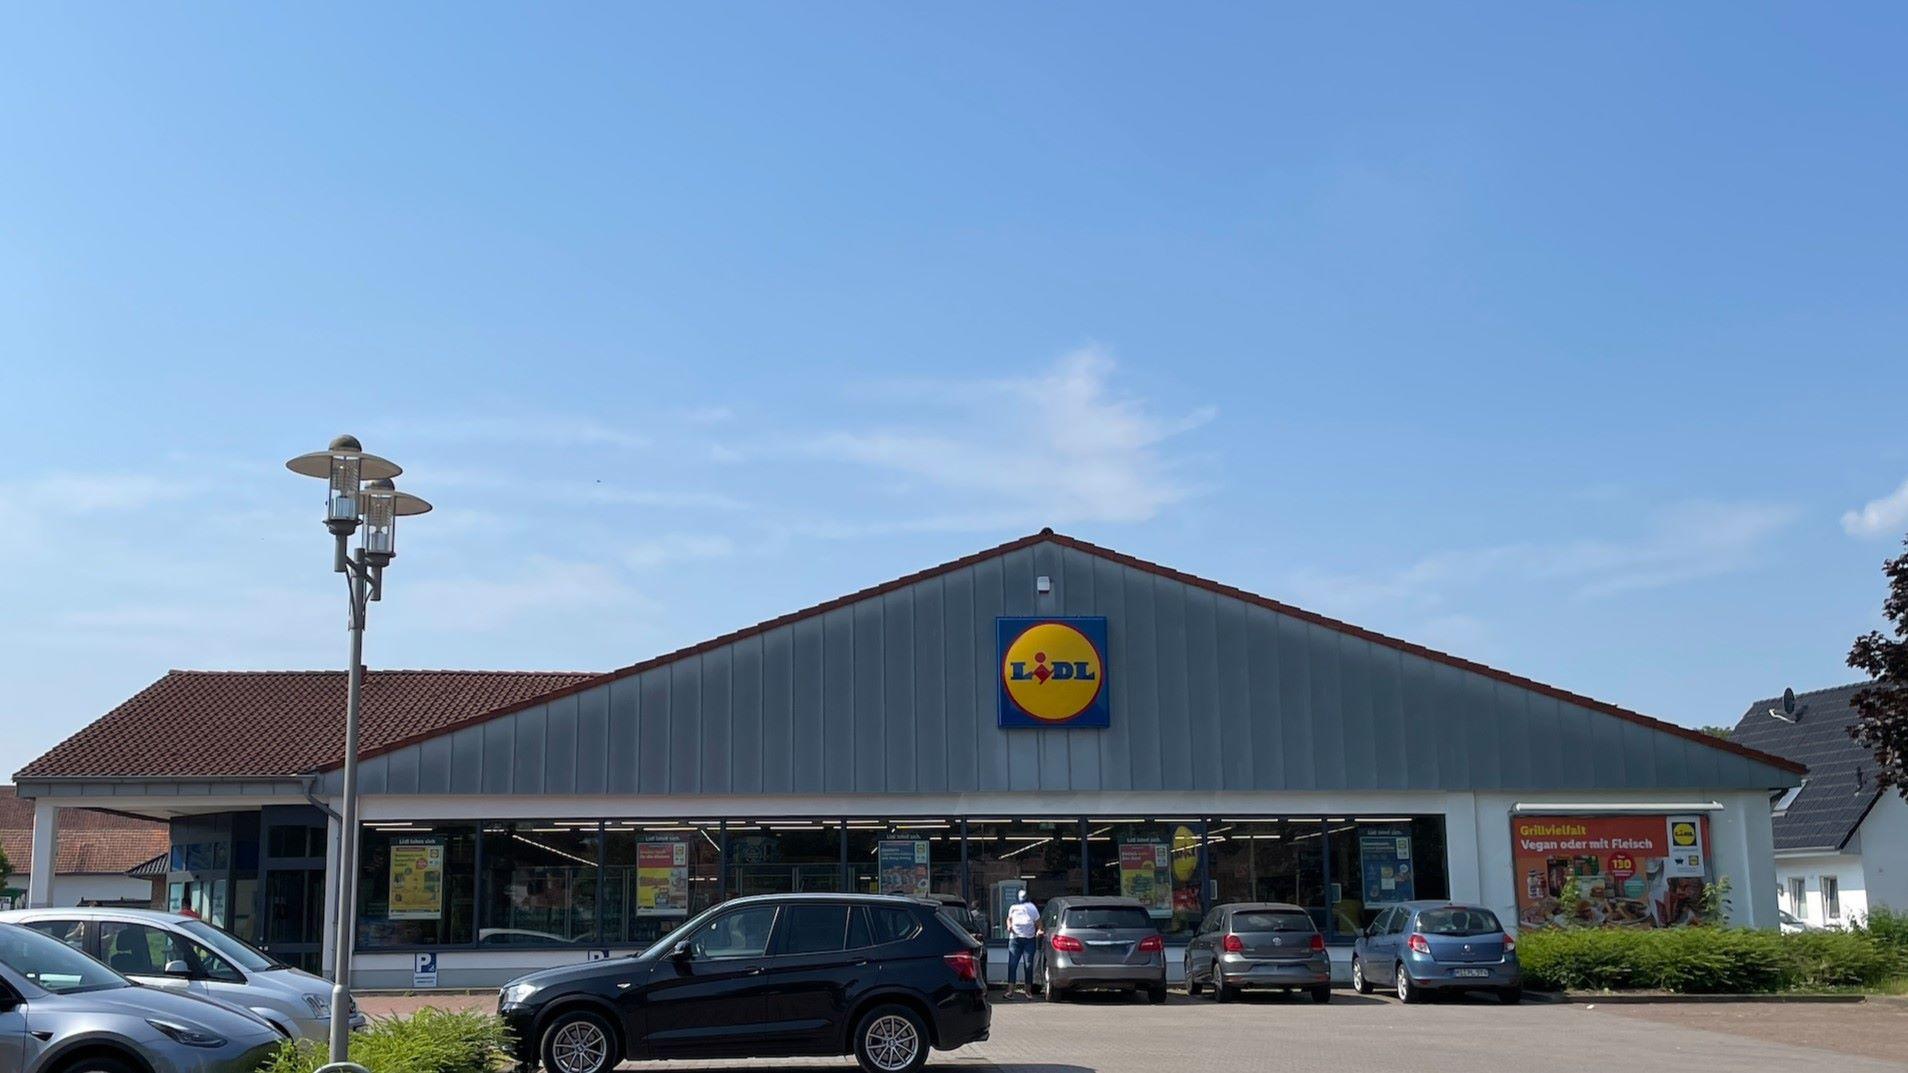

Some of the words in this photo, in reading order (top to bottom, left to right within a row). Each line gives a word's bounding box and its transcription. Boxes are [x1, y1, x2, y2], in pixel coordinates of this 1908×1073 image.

[1520, 825, 1586, 836] Grillvielfalt
[1521, 840, 1557, 852] Vegan
[1560, 839, 1587, 849] oder
[1590, 839, 1608, 849] mit
[1612, 838, 1653, 849] Fleisch
